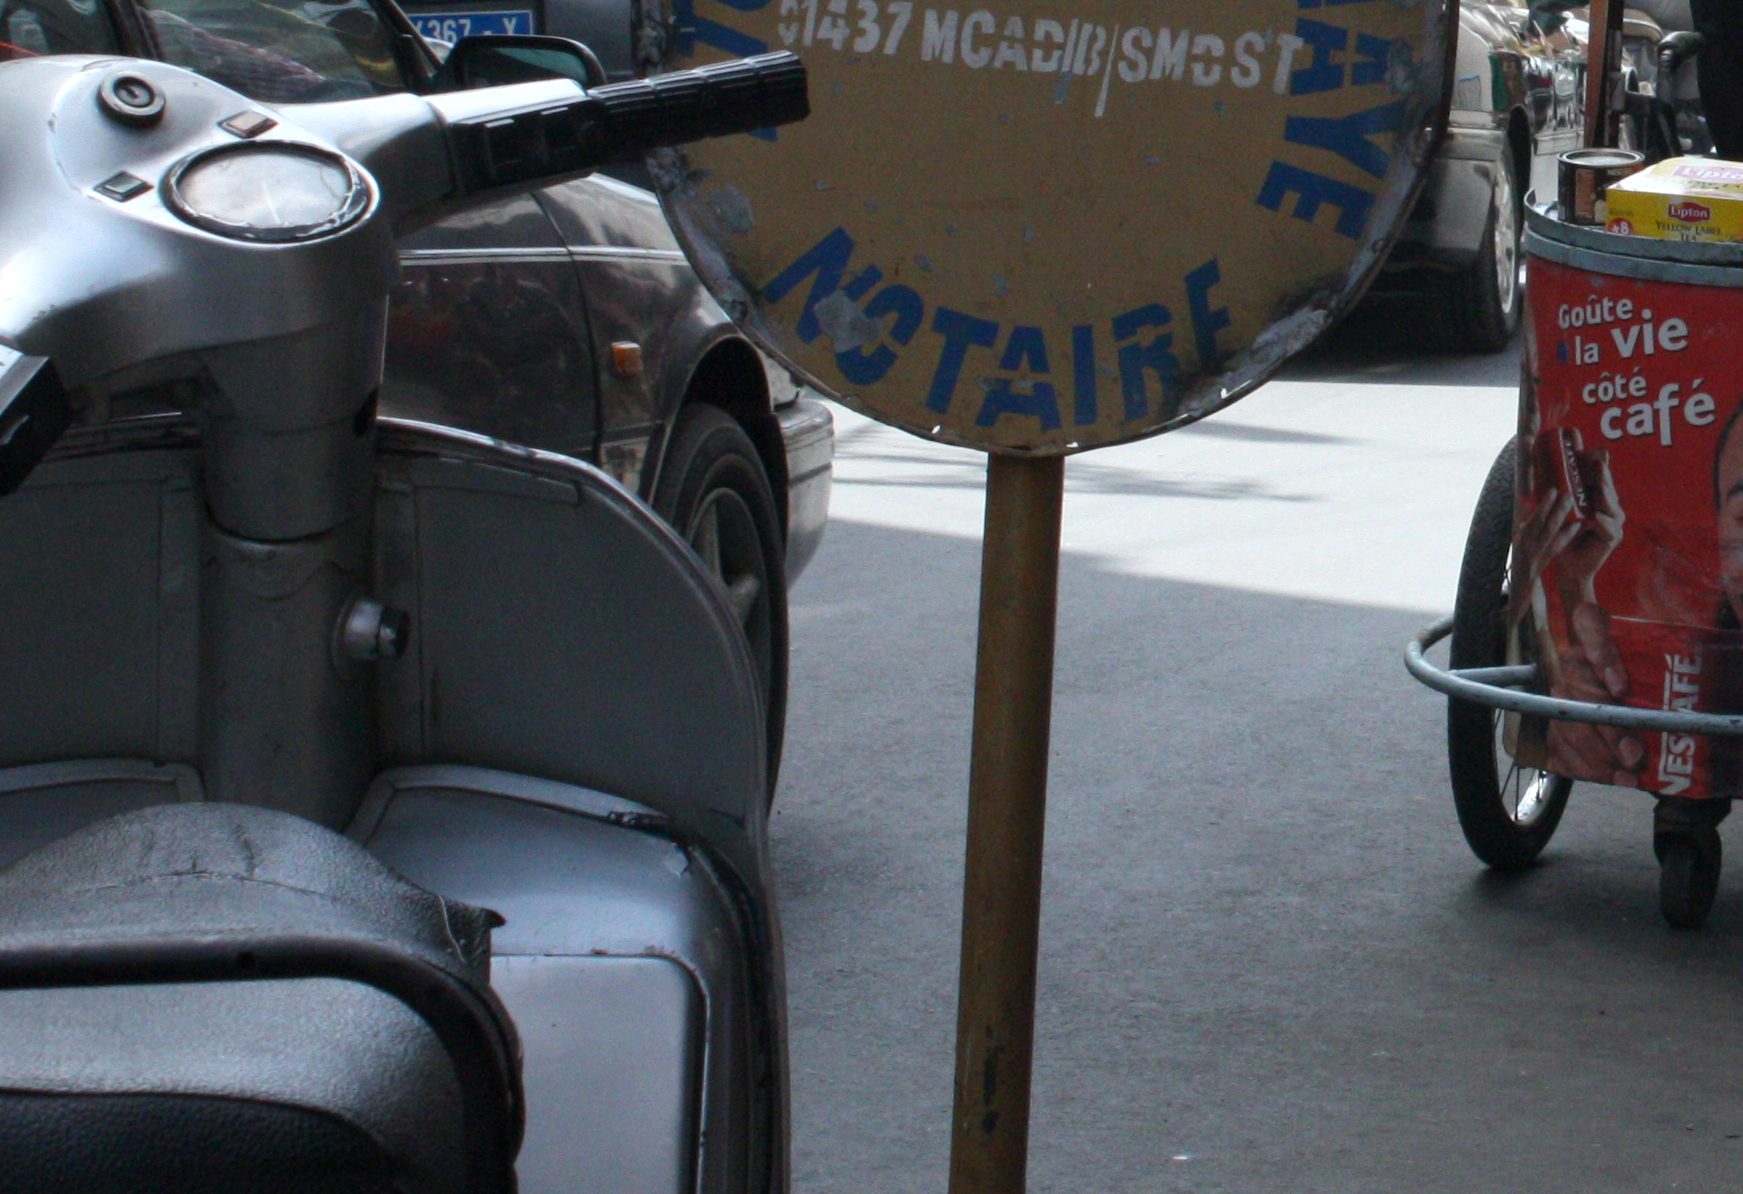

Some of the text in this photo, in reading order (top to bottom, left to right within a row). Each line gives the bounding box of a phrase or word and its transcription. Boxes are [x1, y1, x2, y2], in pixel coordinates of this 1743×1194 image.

[1670, 206, 1708, 219] Lipton
[1558, 294, 1634, 330] Goûte
[1574, 308, 1690, 366] la vie
[1582, 366, 1648, 404] côté
[1600, 378, 1716, 446] café
[1658, 653, 1702, 796] NESAFÉ
